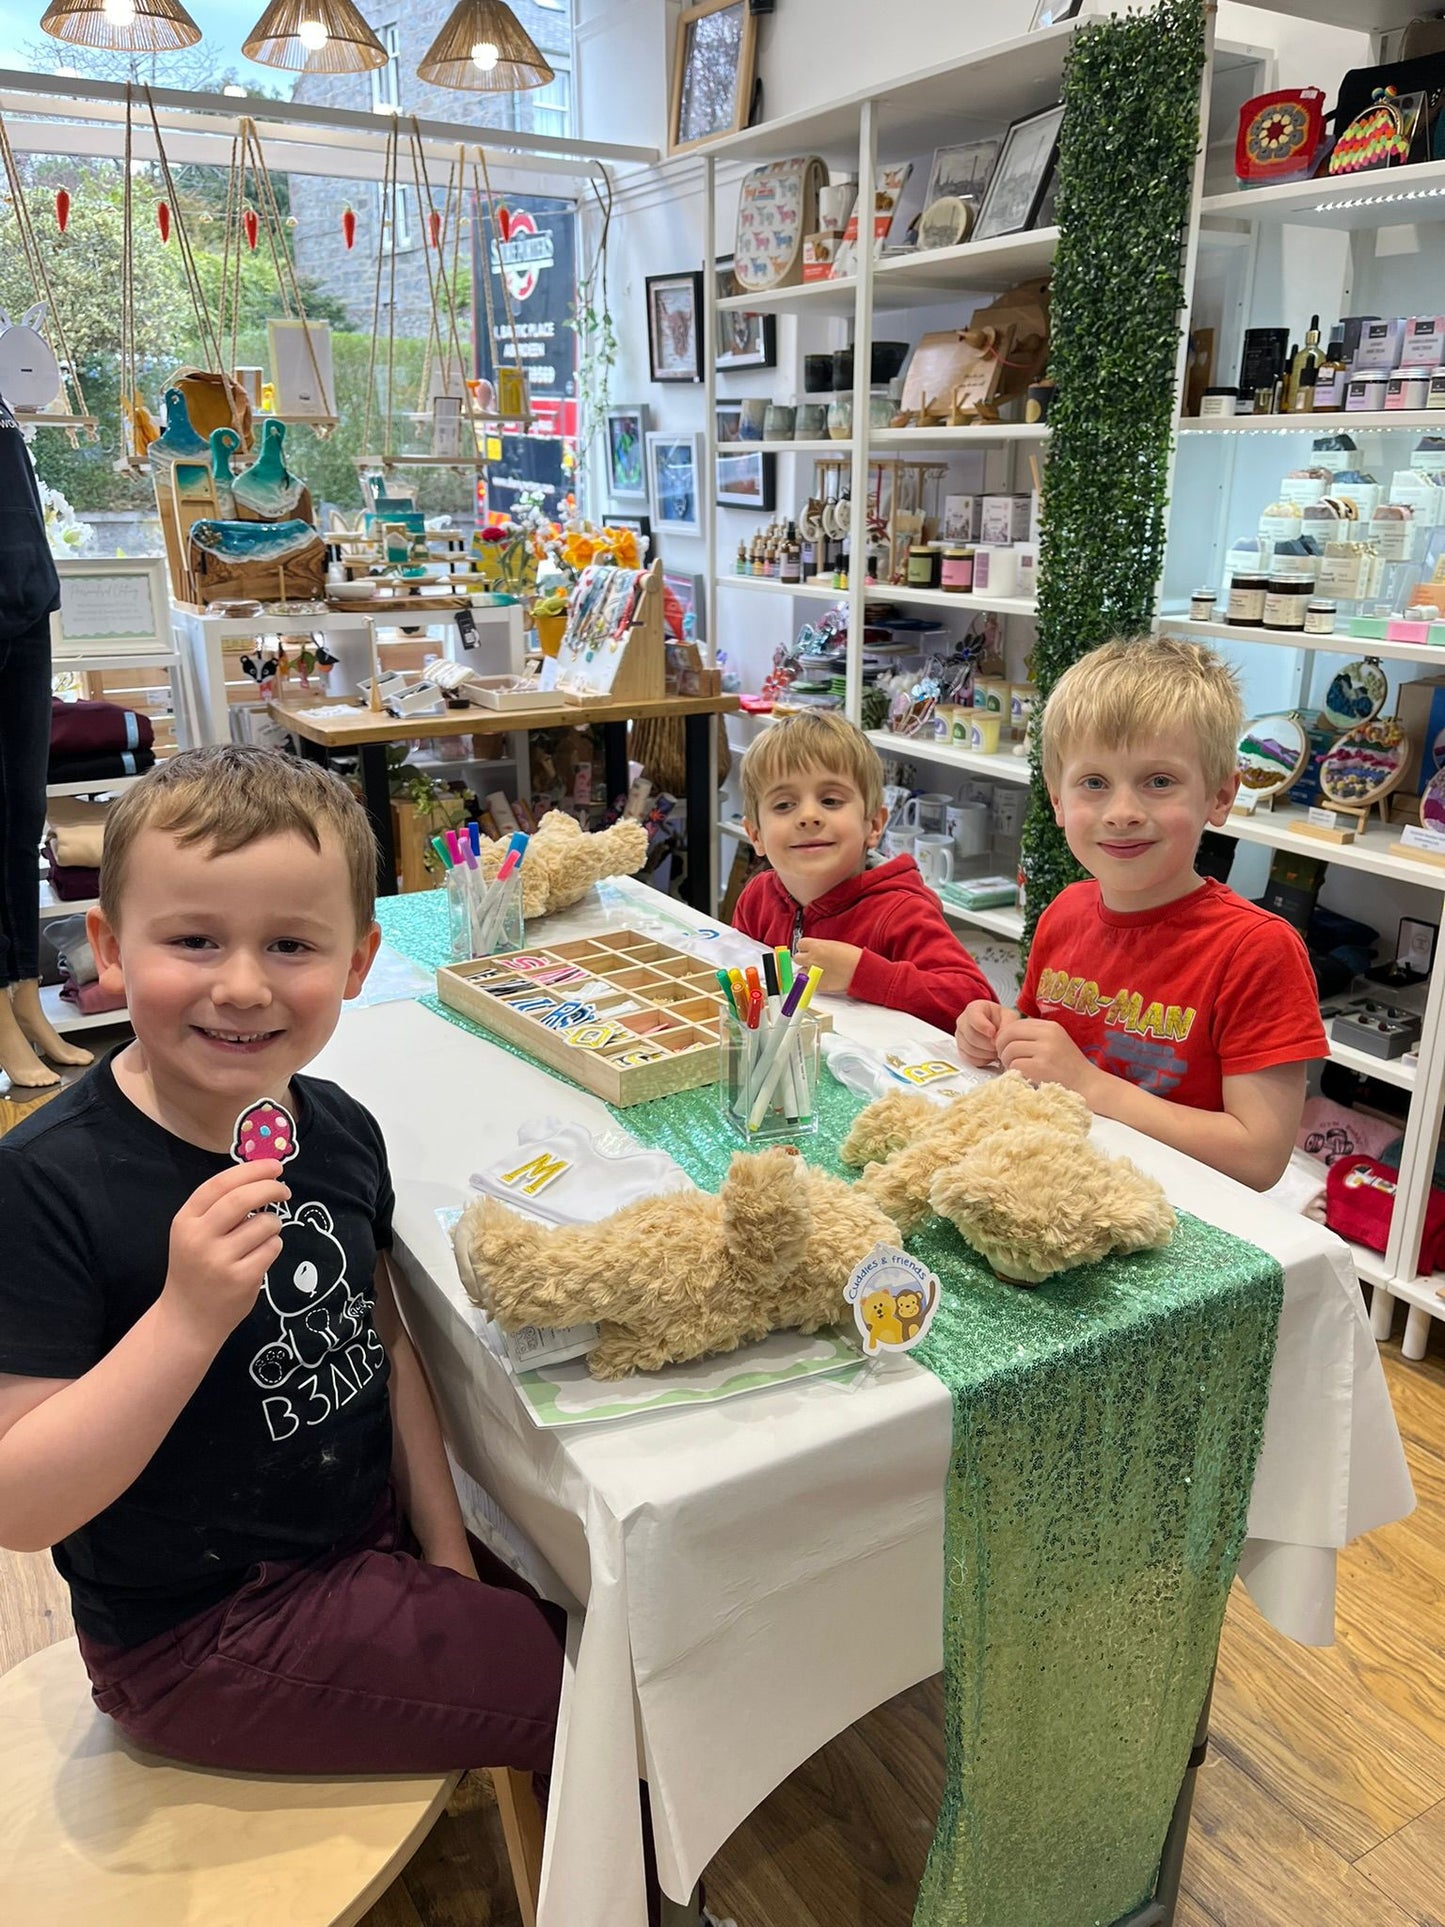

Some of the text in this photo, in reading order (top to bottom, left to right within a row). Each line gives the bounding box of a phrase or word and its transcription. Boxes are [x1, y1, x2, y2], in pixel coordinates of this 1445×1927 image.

[501, 1152, 569, 1194] M
[848, 1255, 927, 1300] Cuddles & friends
